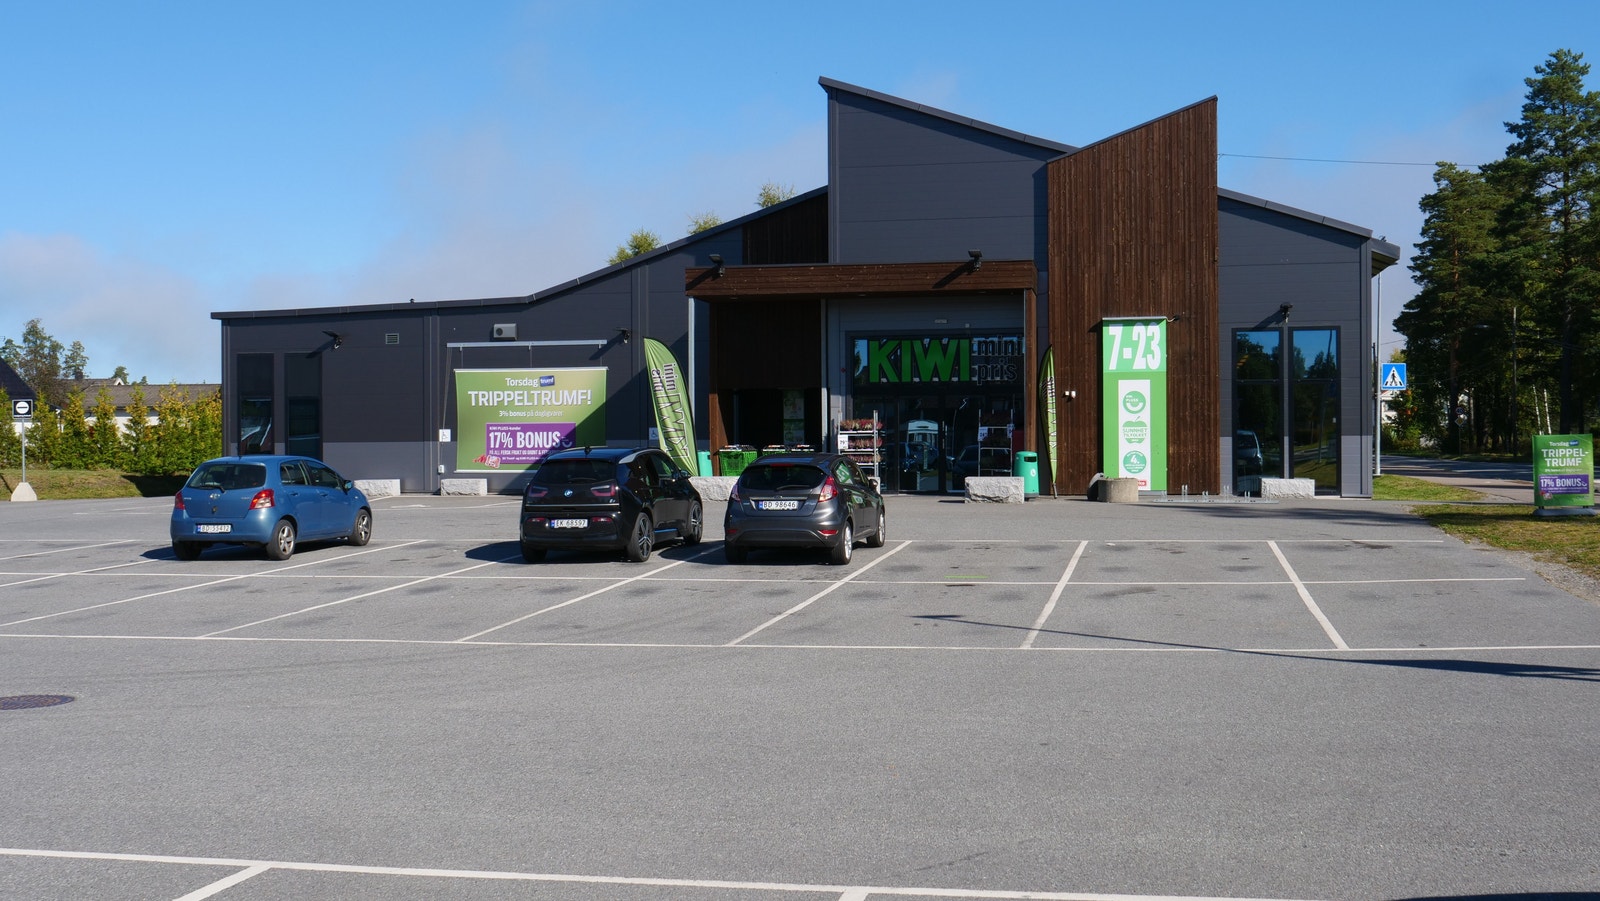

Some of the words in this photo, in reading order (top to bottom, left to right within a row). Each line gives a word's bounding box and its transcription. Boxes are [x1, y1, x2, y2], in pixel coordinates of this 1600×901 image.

[977, 335, 1023, 356] mini
[1108, 322, 1161, 370] 7-23
[869, 339, 970, 382] KIWI
[977, 358, 1018, 386] pris
[505, 377, 539, 388] Torsdag
[468, 389, 592, 406] TRIPPELTRUMF!
[510, 409, 526, 417] bonus
[489, 431, 513, 448] 17%
[516, 431, 561, 448] BONUS
[1541, 448, 1589, 458] TRIPPEL-
[1545, 458, 1582, 467] TRUMF
[1540, 478, 1554, 487] 17%
[1556, 478, 1582, 487] BONUS
